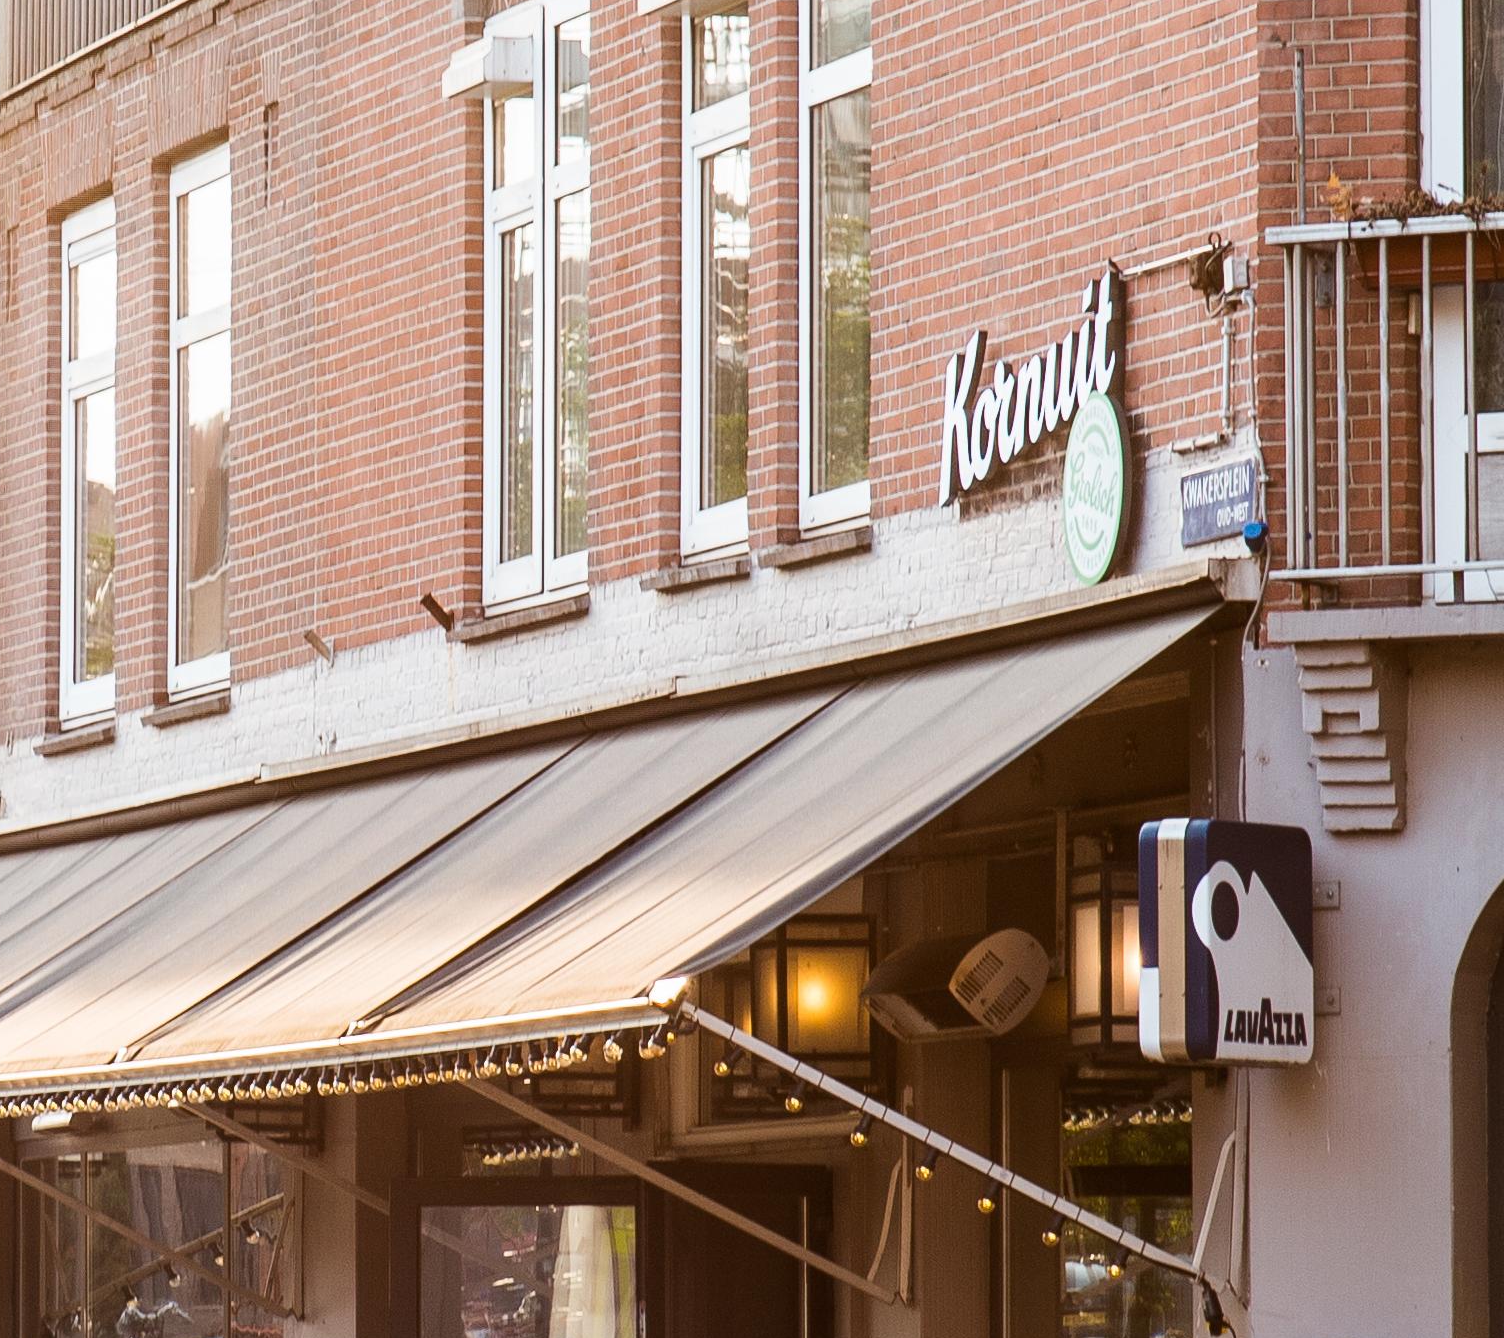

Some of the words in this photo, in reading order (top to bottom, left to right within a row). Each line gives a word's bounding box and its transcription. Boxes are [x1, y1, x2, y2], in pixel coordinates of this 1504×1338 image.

[939, 267, 1117, 508] Kornuit
[1068, 451, 1119, 518] Grolsch
[1183, 464, 1250, 510] KWAKERSPLEIN
[1216, 501, 1249, 527] OUD-WEST
[1224, 997, 1307, 1046] LAVAZZA
